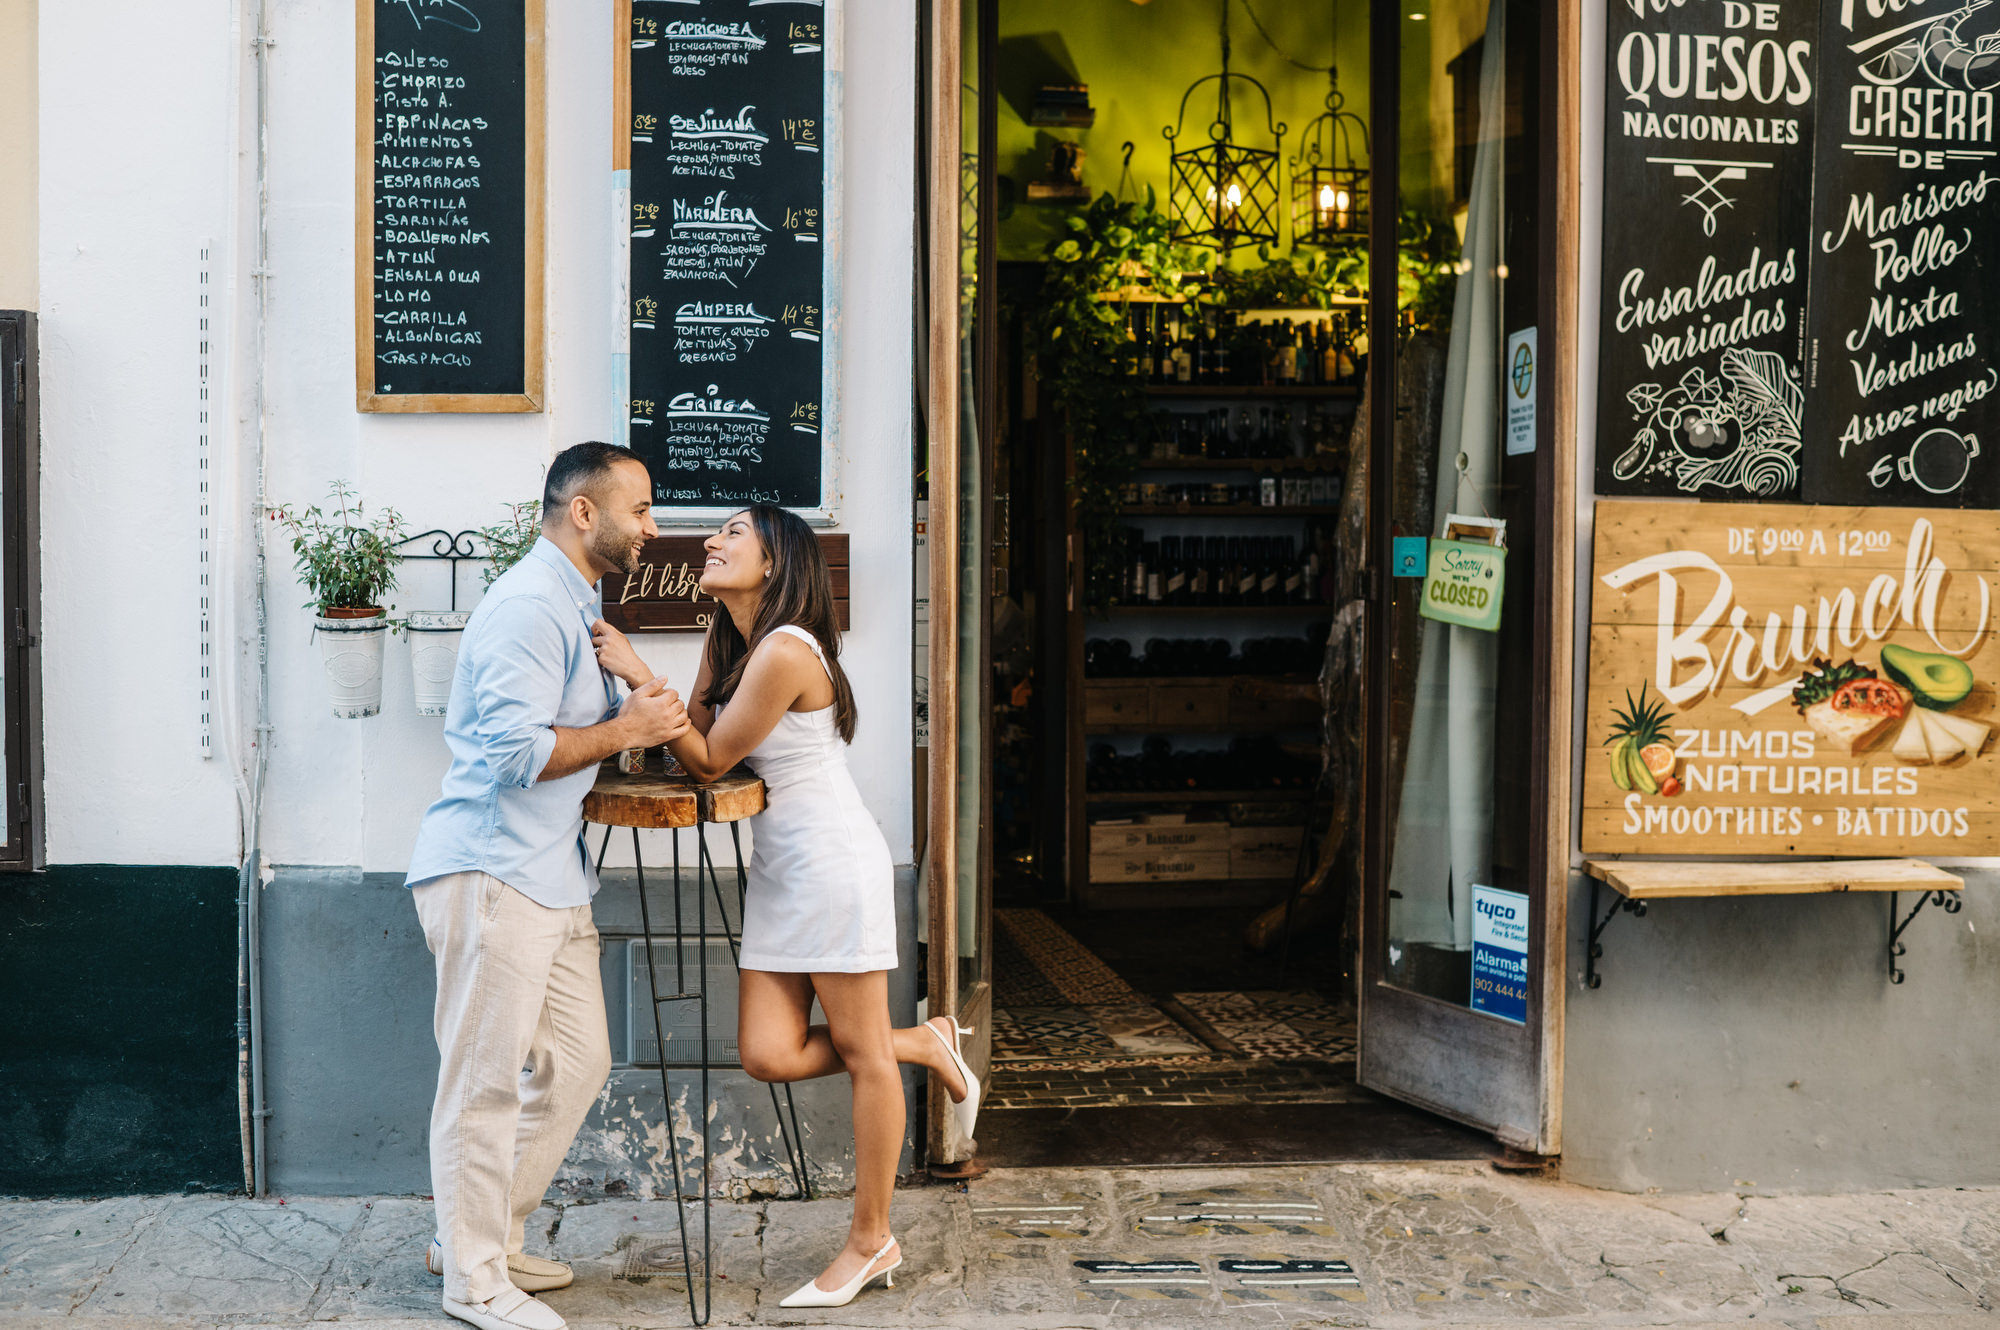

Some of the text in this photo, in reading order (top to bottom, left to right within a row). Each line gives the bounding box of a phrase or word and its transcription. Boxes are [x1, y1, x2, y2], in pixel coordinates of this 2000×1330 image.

[1722, 1, 1780, 31] DE
[672, 64, 706, 76] QUESO
[1617, 31, 1812, 108] QUESOS
[1622, 111, 1799, 144] NACIONALES
[1850, 85, 1993, 142] CASERA
[1899, 149, 1945, 170] DE
[1822, 170, 2000, 253] Mariscos
[1869, 224, 1971, 291] Pollo
[1616, 246, 1796, 334] Ensaladas
[731, 326, 769, 337] QUESO
[1846, 286, 1962, 351] Mixta
[1642, 298, 1786, 370] variadas
[1850, 333, 1977, 398] Verduras
[724, 422, 770, 433] TOMATE
[1838, 368, 1998, 458] Arroz negro
[1727, 527, 1755, 555] DE
[1808, 529, 1827, 555] A
[1441, 548, 1484, 578] Sorry
[659, 562, 707, 603] libr
[1430, 580, 1489, 609] CLOSED
[1601, 517, 1990, 705] Brunch
[1674, 729, 1815, 759] ZUMOS
[1685, 764, 1918, 796] NATURALES
[1837, 807, 1969, 837] BATIDOS
[1476, 898, 1516, 920] tyco
[1491, 928, 1502, 937] Fire
[1494, 918, 1525, 931] Integrated
[1475, 948, 1519, 973] Alarma
[1475, 977, 1494, 993] 902
[1495, 983, 1514, 998] 444
